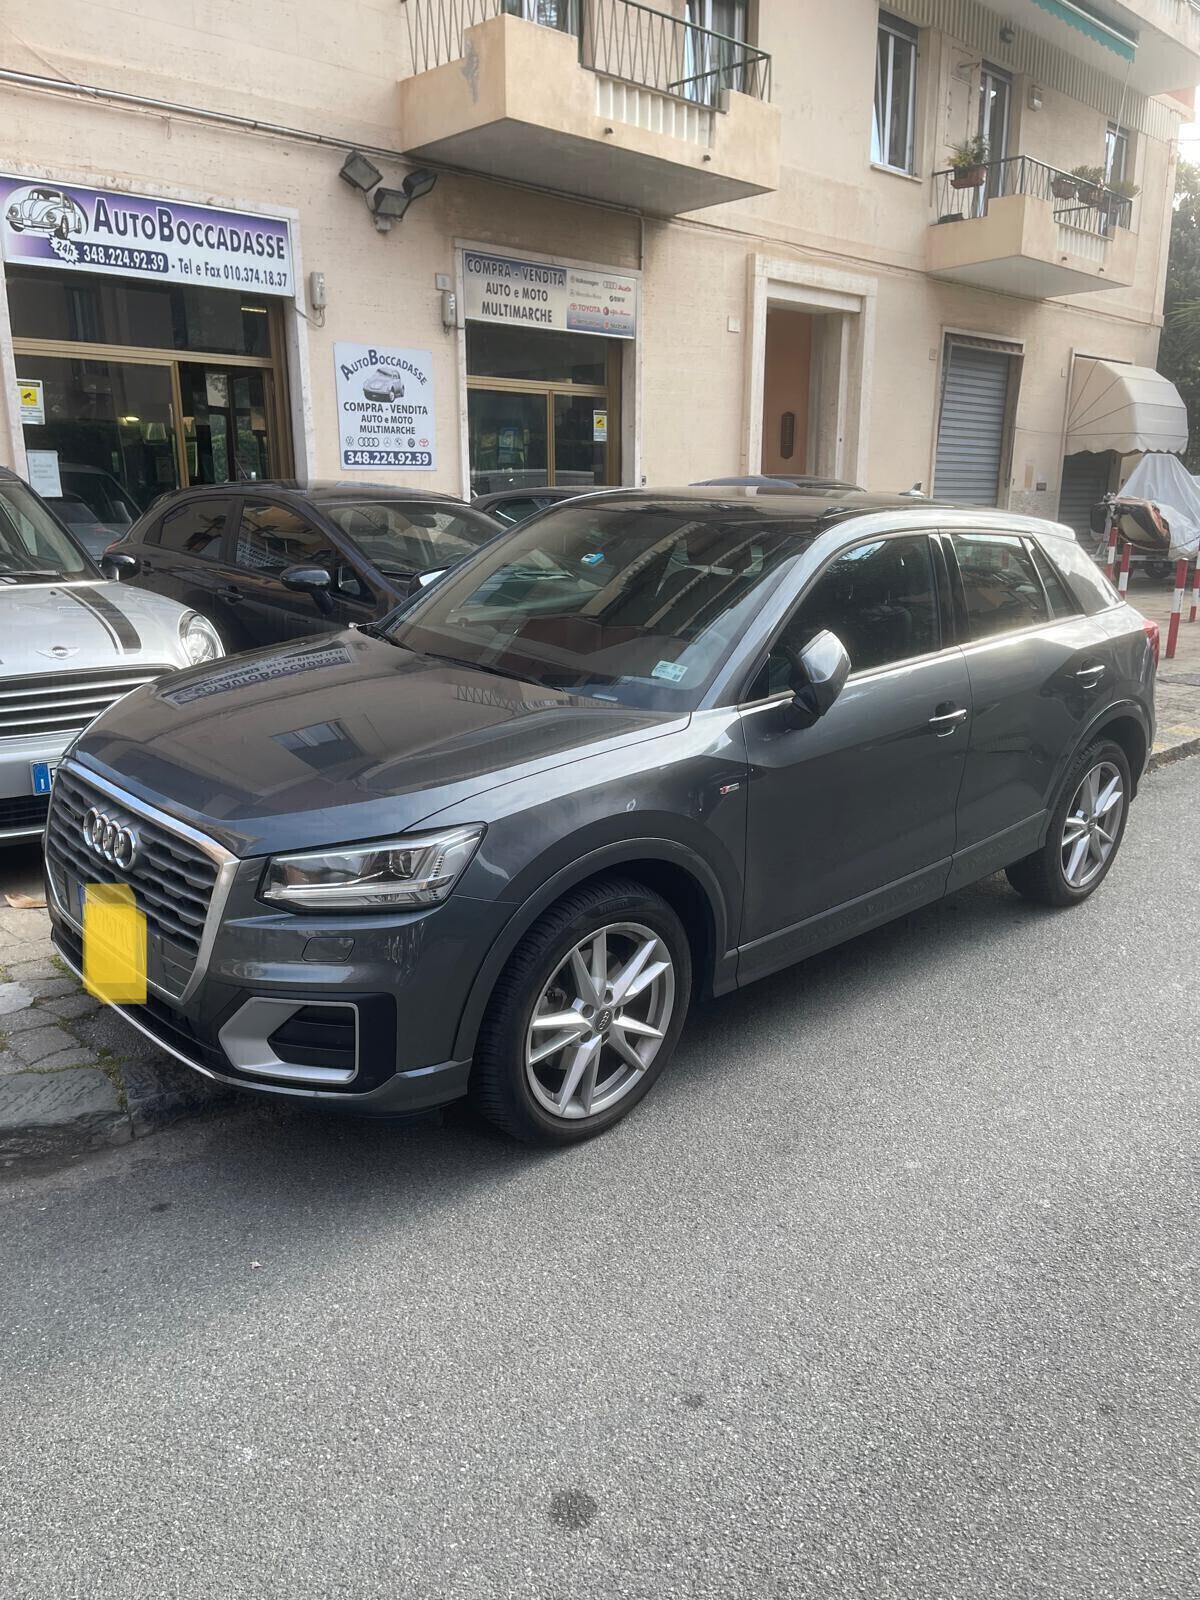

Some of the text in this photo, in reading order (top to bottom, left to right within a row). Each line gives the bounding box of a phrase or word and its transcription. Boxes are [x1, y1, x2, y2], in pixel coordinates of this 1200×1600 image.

[56, 240, 74, 257] 24h
[83, 244, 165, 271] 348.224.92.39
[178, 257, 193, 275] Tel
[195, 263, 201, 276] e
[204, 261, 221, 278] Fax
[223, 264, 288, 288] 010.374.18.37
[467, 259, 512, 278] COMPRA
[522, 267, 565, 287] VENDITA
[485, 281, 549, 303] AUTO e MOTO
[481, 300, 553, 323] MULTIMARCHE
[578, 304, 601, 314] TOYOTA
[343, 401, 384, 413] COMPRA
[390, 404, 428, 415] VENDITA
[361, 414, 383, 424] AUTO
[390, 415, 413, 425] MOTO
[359, 425, 416, 435] MULTIMARCHE
[347, 452, 429, 465] 348.224.92.39
